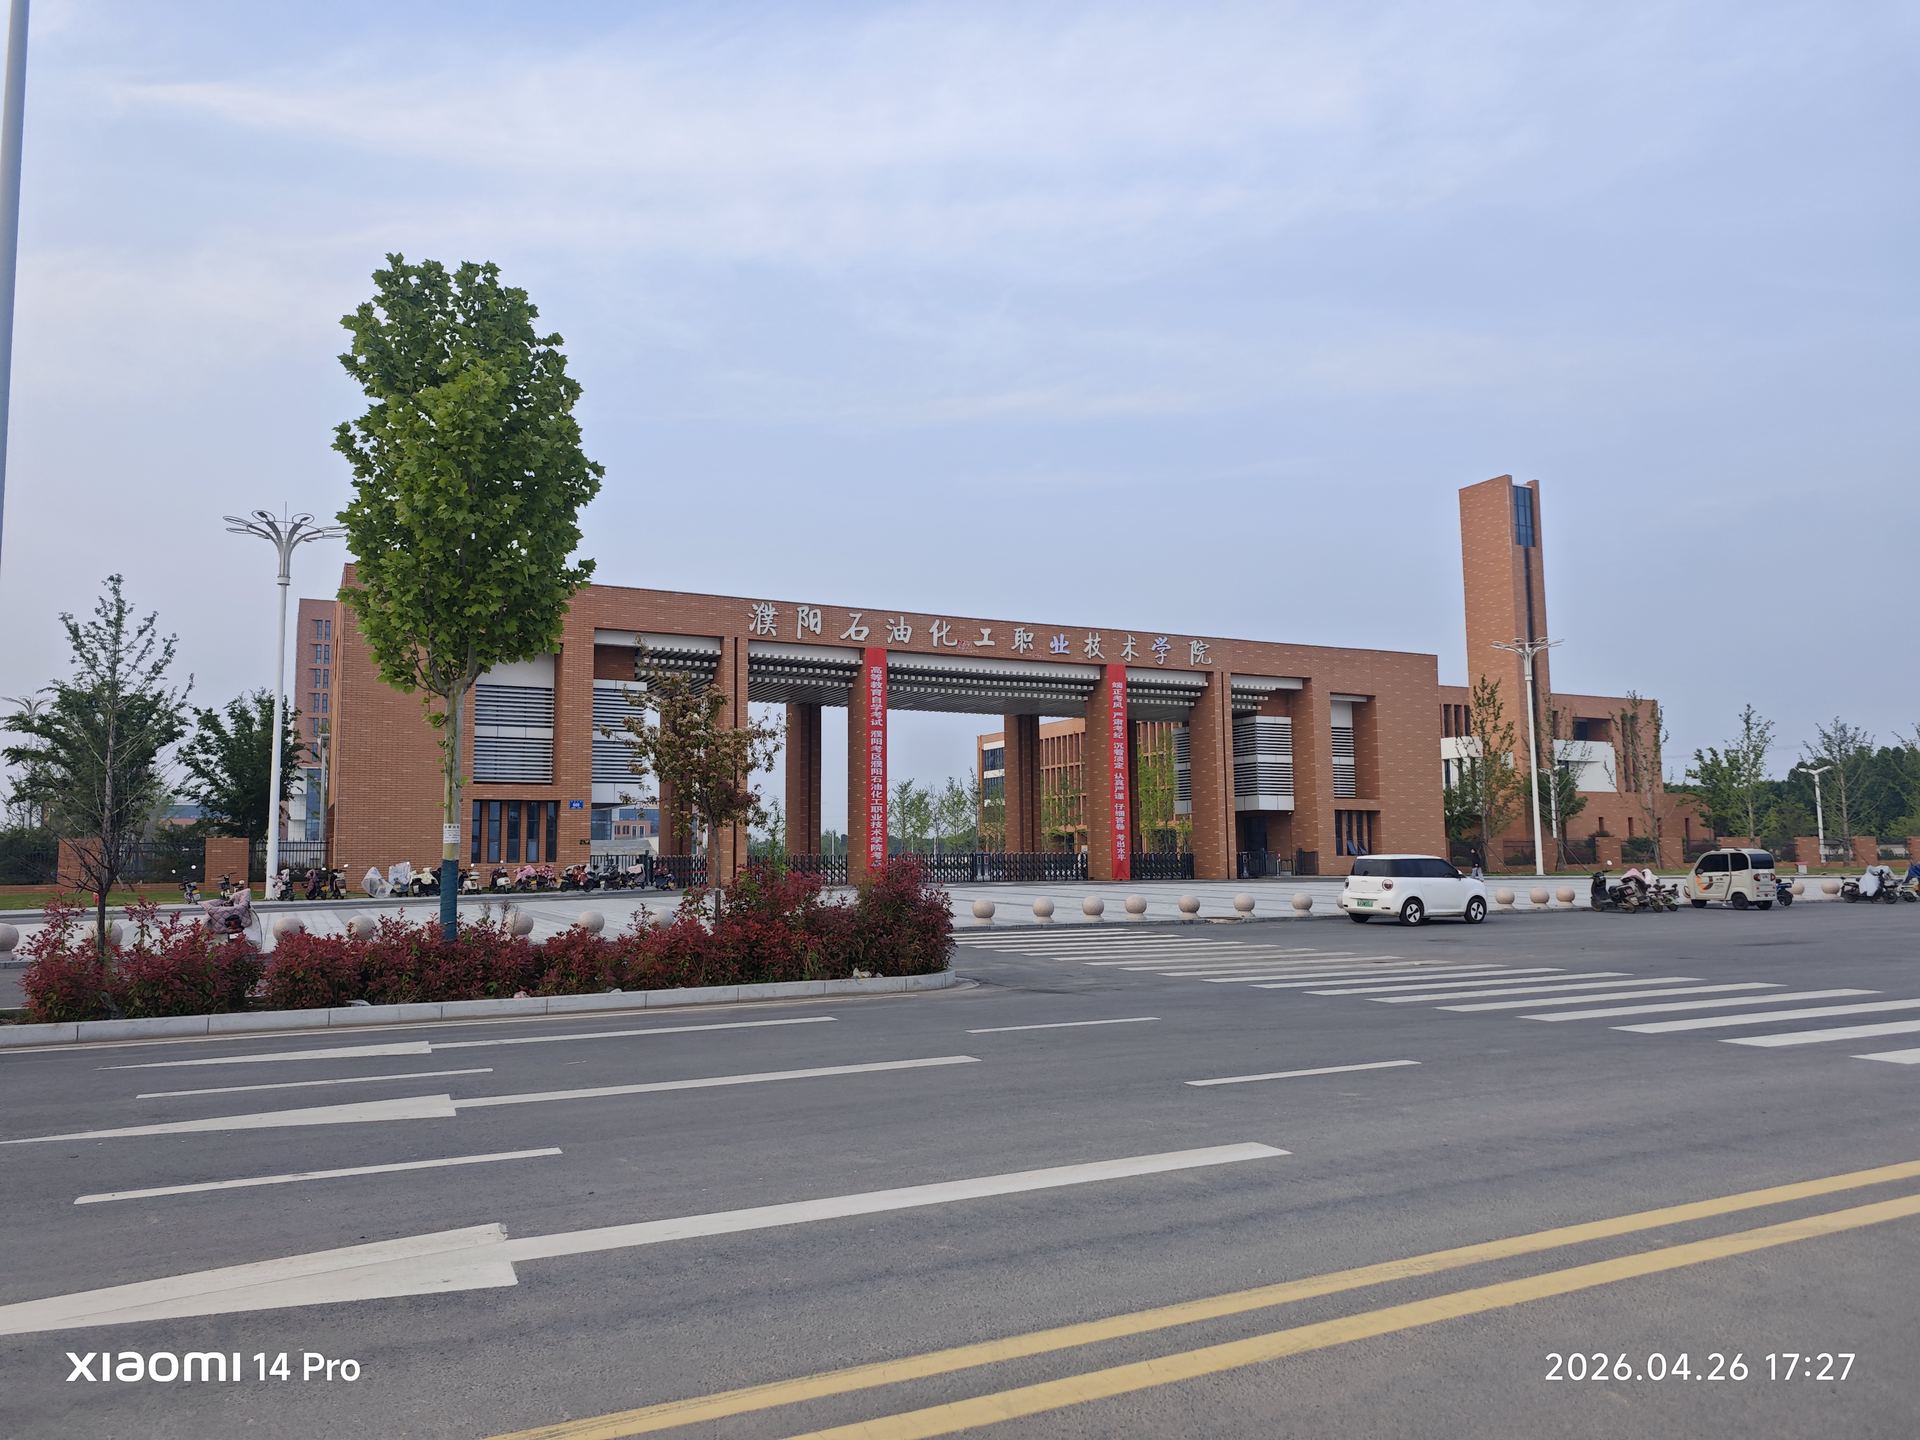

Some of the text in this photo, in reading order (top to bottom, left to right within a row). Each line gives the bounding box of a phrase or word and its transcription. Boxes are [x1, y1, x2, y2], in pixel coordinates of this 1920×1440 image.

[748, 601, 1212, 667] 濮阳石油化工职业技术学院
[871, 666, 883, 726] 高等教育自学考试
[1112, 682, 1123, 708] 端正考风
[1113, 712, 1124, 739] 严肃考纪
[1114, 773, 1125, 800] 认真严谨
[1114, 803, 1125, 831] 仔细答卷
[1116, 834, 1126, 862] 考出水平
